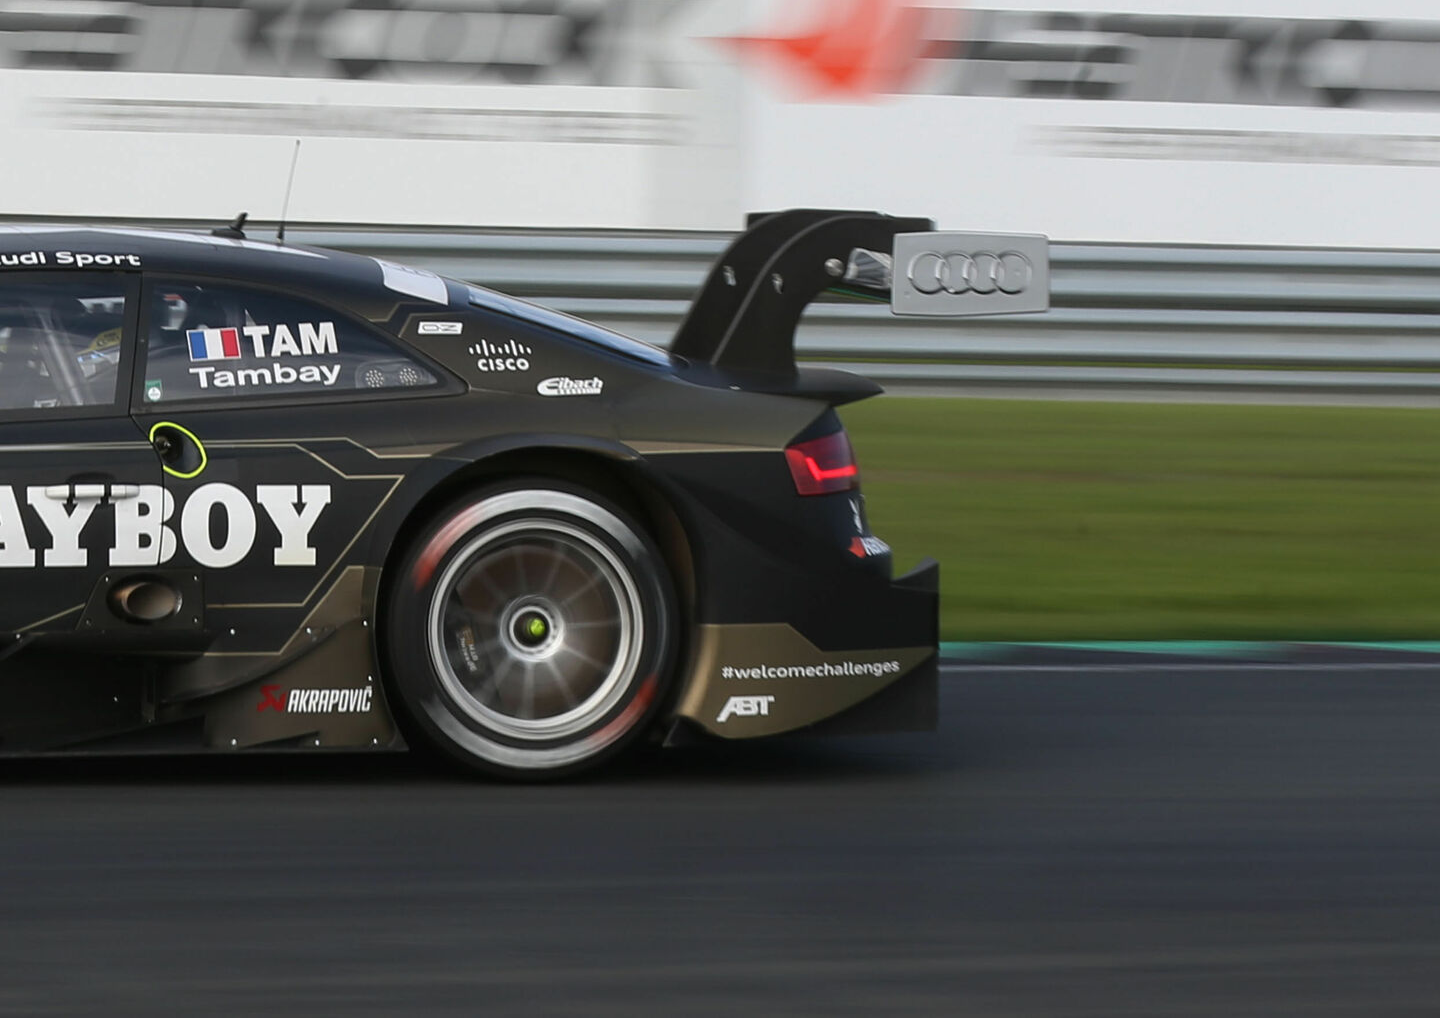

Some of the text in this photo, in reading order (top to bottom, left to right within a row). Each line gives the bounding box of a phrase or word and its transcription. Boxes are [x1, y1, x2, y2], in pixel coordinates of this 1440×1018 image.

[56, 251, 142, 268] Sport
[242, 321, 338, 358] TAM
[189, 362, 341, 388] Tambay
[721, 660, 900, 680] #welcomechallenges
[716, 695, 775, 723] ABT
